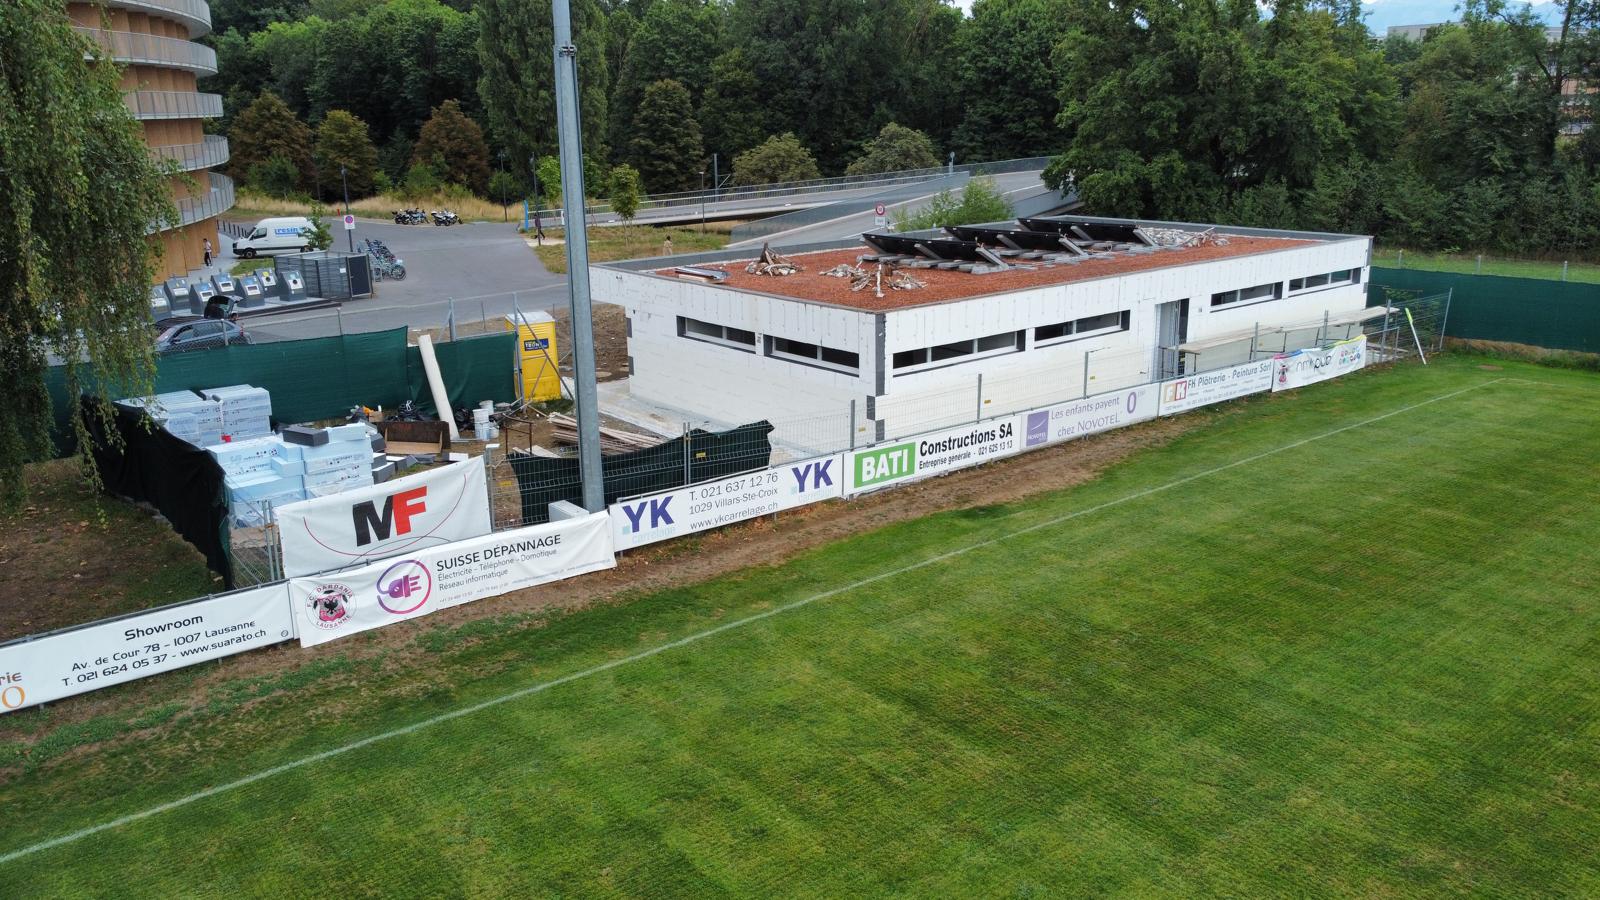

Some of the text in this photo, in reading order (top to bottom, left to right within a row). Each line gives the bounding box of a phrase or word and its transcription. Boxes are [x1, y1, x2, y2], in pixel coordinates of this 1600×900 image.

[1232, 366, 1258, 379] Peinture
[1165, 381, 1187, 403] FK
[1051, 410, 1065, 420] Les
[1065, 403, 1094, 417] enfants
[1094, 396, 1120, 411] payent
[919, 422, 1013, 457] Constructions SA
[1057, 412, 1121, 438] chez NOVOTEL
[862, 449, 908, 483] BATI
[919, 440, 1013, 470] Entreprise générale 021 625 13 13
[688, 472, 778, 501] T. 021 637 12 76
[792, 459, 833, 493] YK
[352, 485, 428, 547] MF
[622, 496, 675, 533] YK
[689, 487, 778, 516] 1029 Villars-Ste-Croix
[690, 501, 778, 531] www.ykcarrelage.ch
[631, 526, 676, 545] carrelage
[436, 533, 562, 572] SUISSE DÉPANNAGE
[437, 566, 473, 582] Électricité
[479, 558, 515, 574] Téléphone
[520, 549, 558, 563] Domotique
[316, 584, 353, 599] DARDANIA
[439, 579, 465, 591] Réseau
[465, 568, 509, 585] informatique
[124, 615, 204, 641] Showroom
[316, 614, 351, 629] LAUSANNE
[62, 677, 73, 687] T.
[77, 670, 99, 684] 021
[102, 663, 129, 678] 624
[132, 658, 149, 670] 05
[153, 653, 168, 665] 37
[180, 629, 267, 658] www.suarato.ch
[71, 661, 91, 672] Av.
[94, 656, 109, 667] de
[112, 650, 141, 662] Cour
[143, 643, 161, 654] 78
[173, 632, 202, 647] 1007
[204, 619, 257, 639] Lausanne
